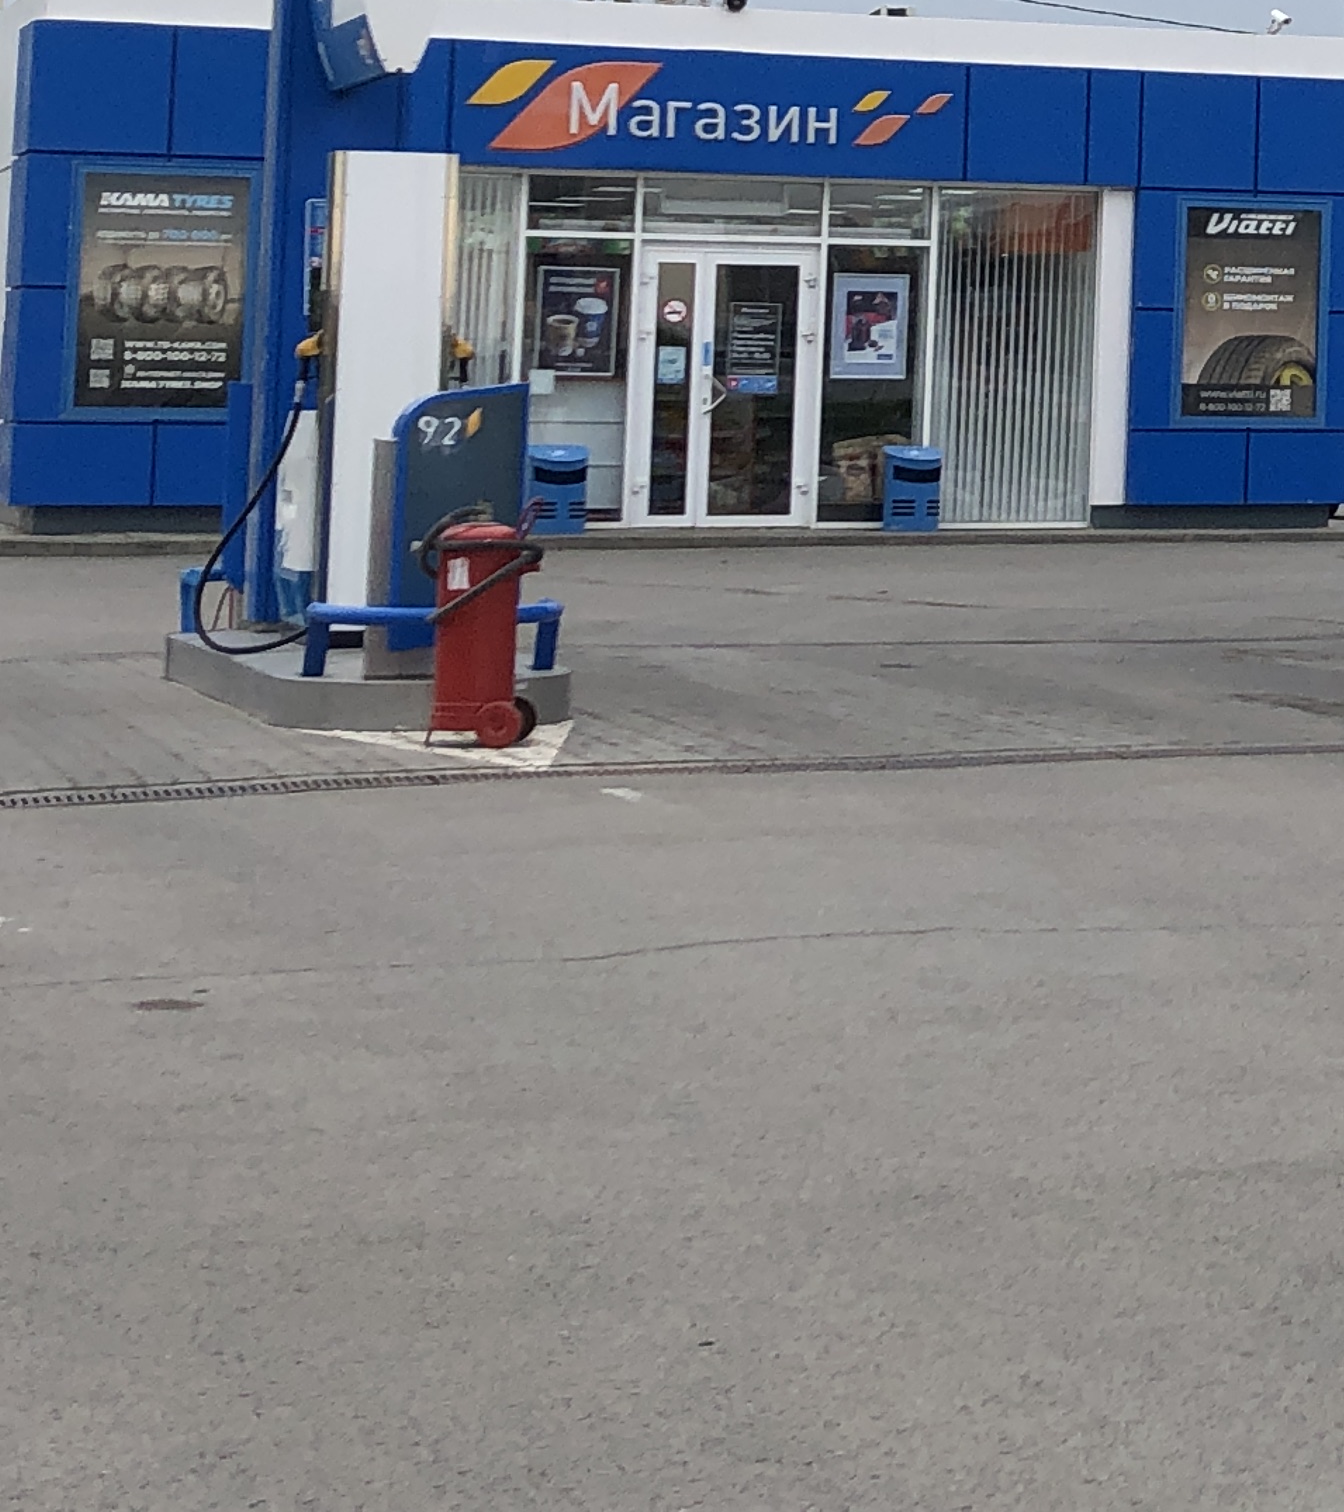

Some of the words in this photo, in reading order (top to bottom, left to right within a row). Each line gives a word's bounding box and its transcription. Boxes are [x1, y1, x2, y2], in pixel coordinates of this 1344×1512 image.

[567, 80, 838, 145] Магазин
[172, 193, 234, 208] TYRES
[1205, 213, 1298, 236] Viatti
[417, 415, 462, 445] 92
